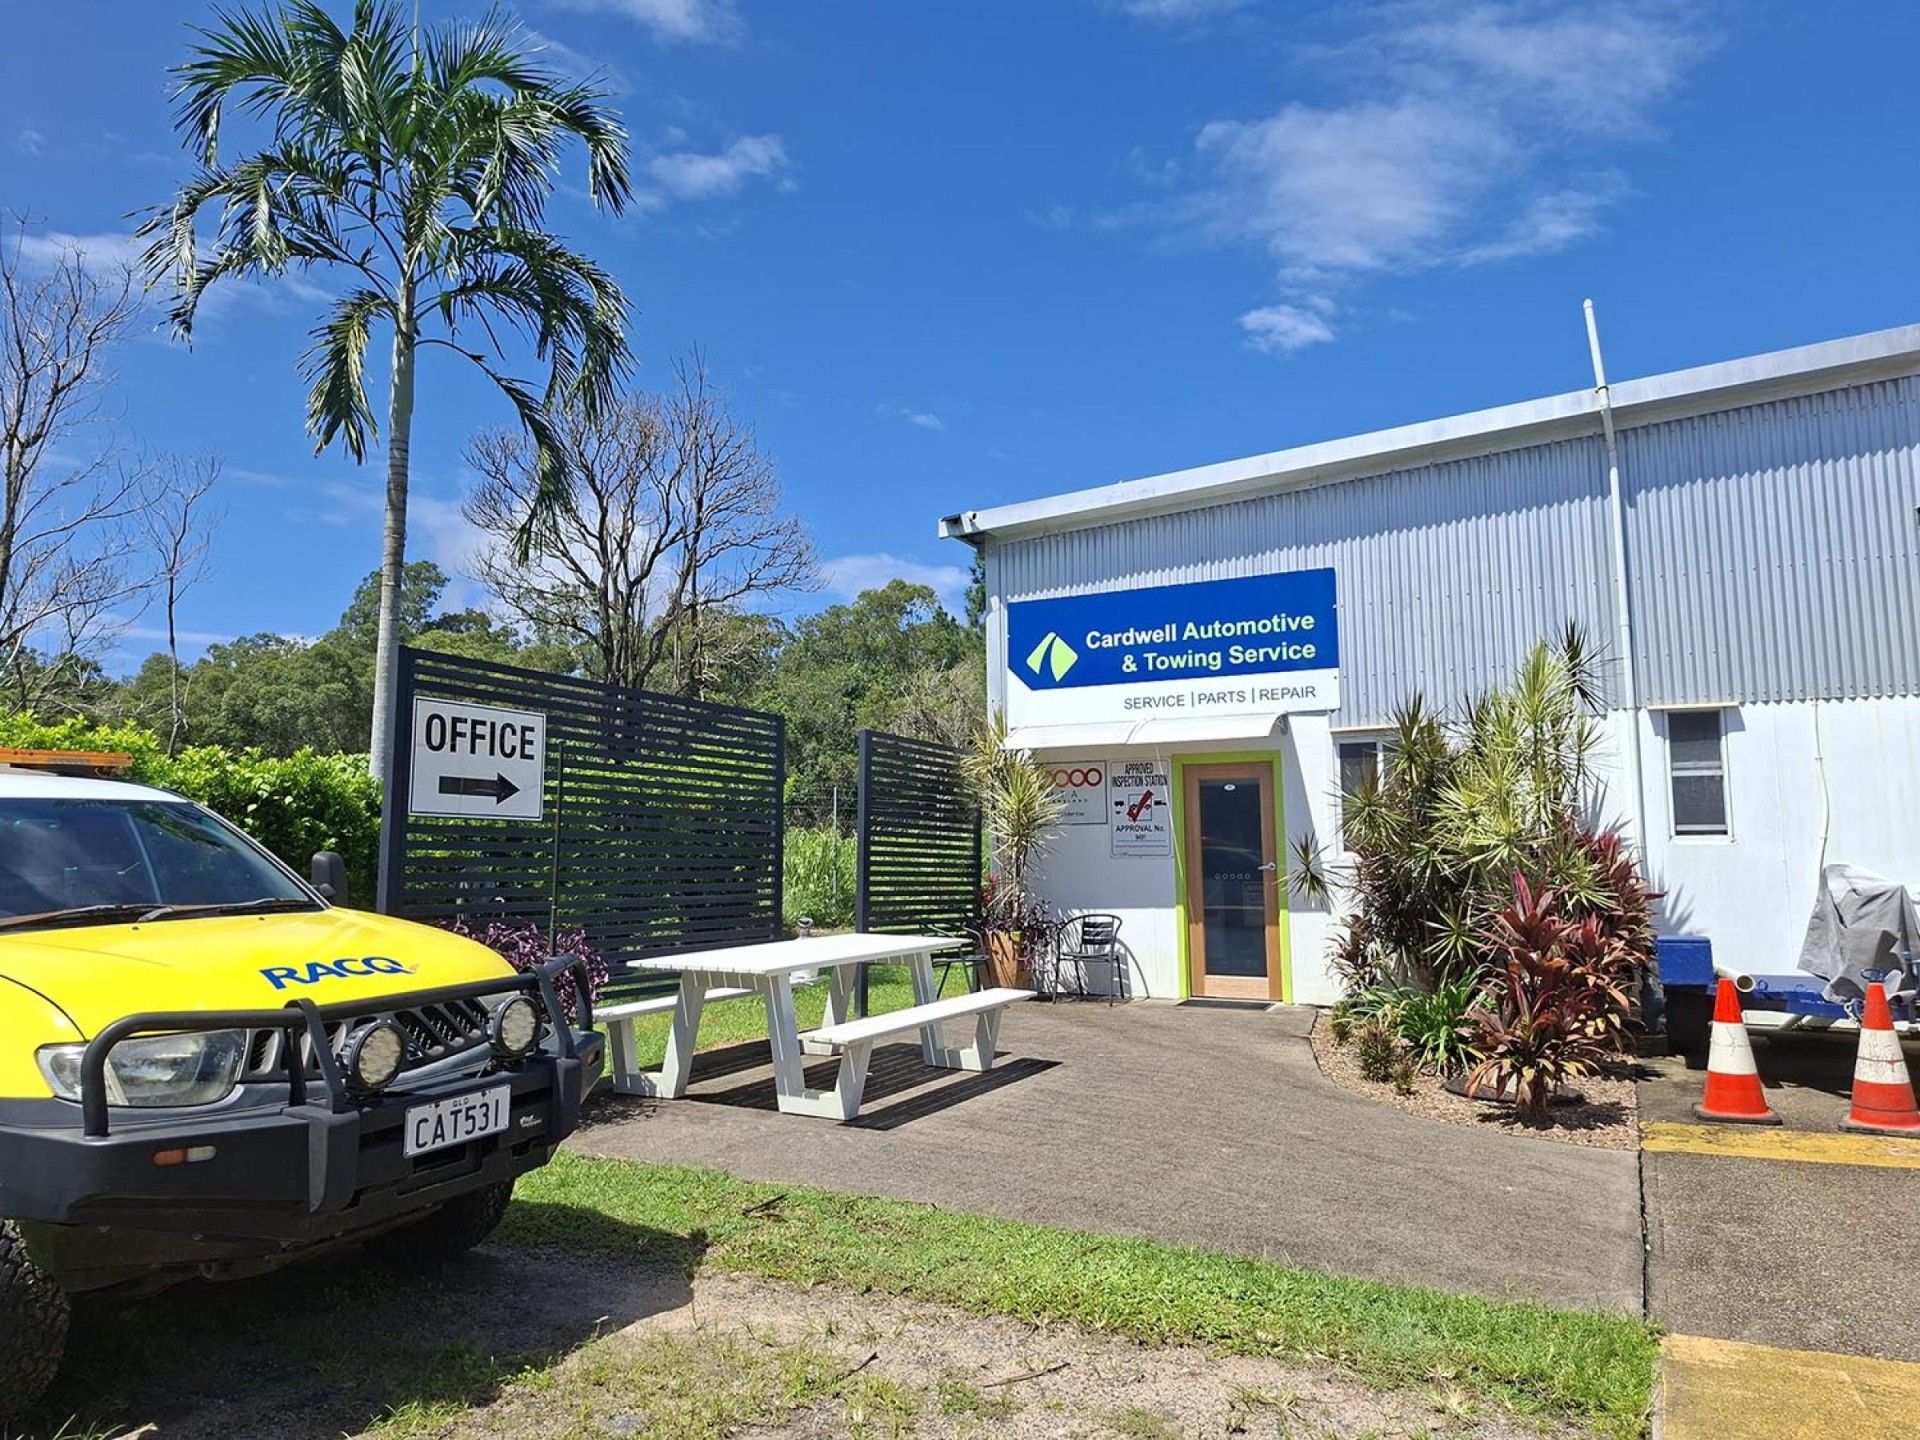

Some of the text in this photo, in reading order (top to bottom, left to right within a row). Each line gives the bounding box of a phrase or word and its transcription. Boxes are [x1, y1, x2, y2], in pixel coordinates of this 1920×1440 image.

[1086, 613, 1315, 649] Cardwell Automotive
[1122, 641, 1316, 672] & Towing Service
[1124, 685, 1317, 710] SERVICE PARTS REPAIR
[425, 713, 535, 760] OFFICE
[1112, 774, 1168, 788] INSPECTION STATION
[1124, 762, 1154, 775] APPROVED
[1116, 824, 1153, 832] APPROVAL
[259, 956, 413, 989] RACQ
[415, 1098, 500, 1149] CAT531
